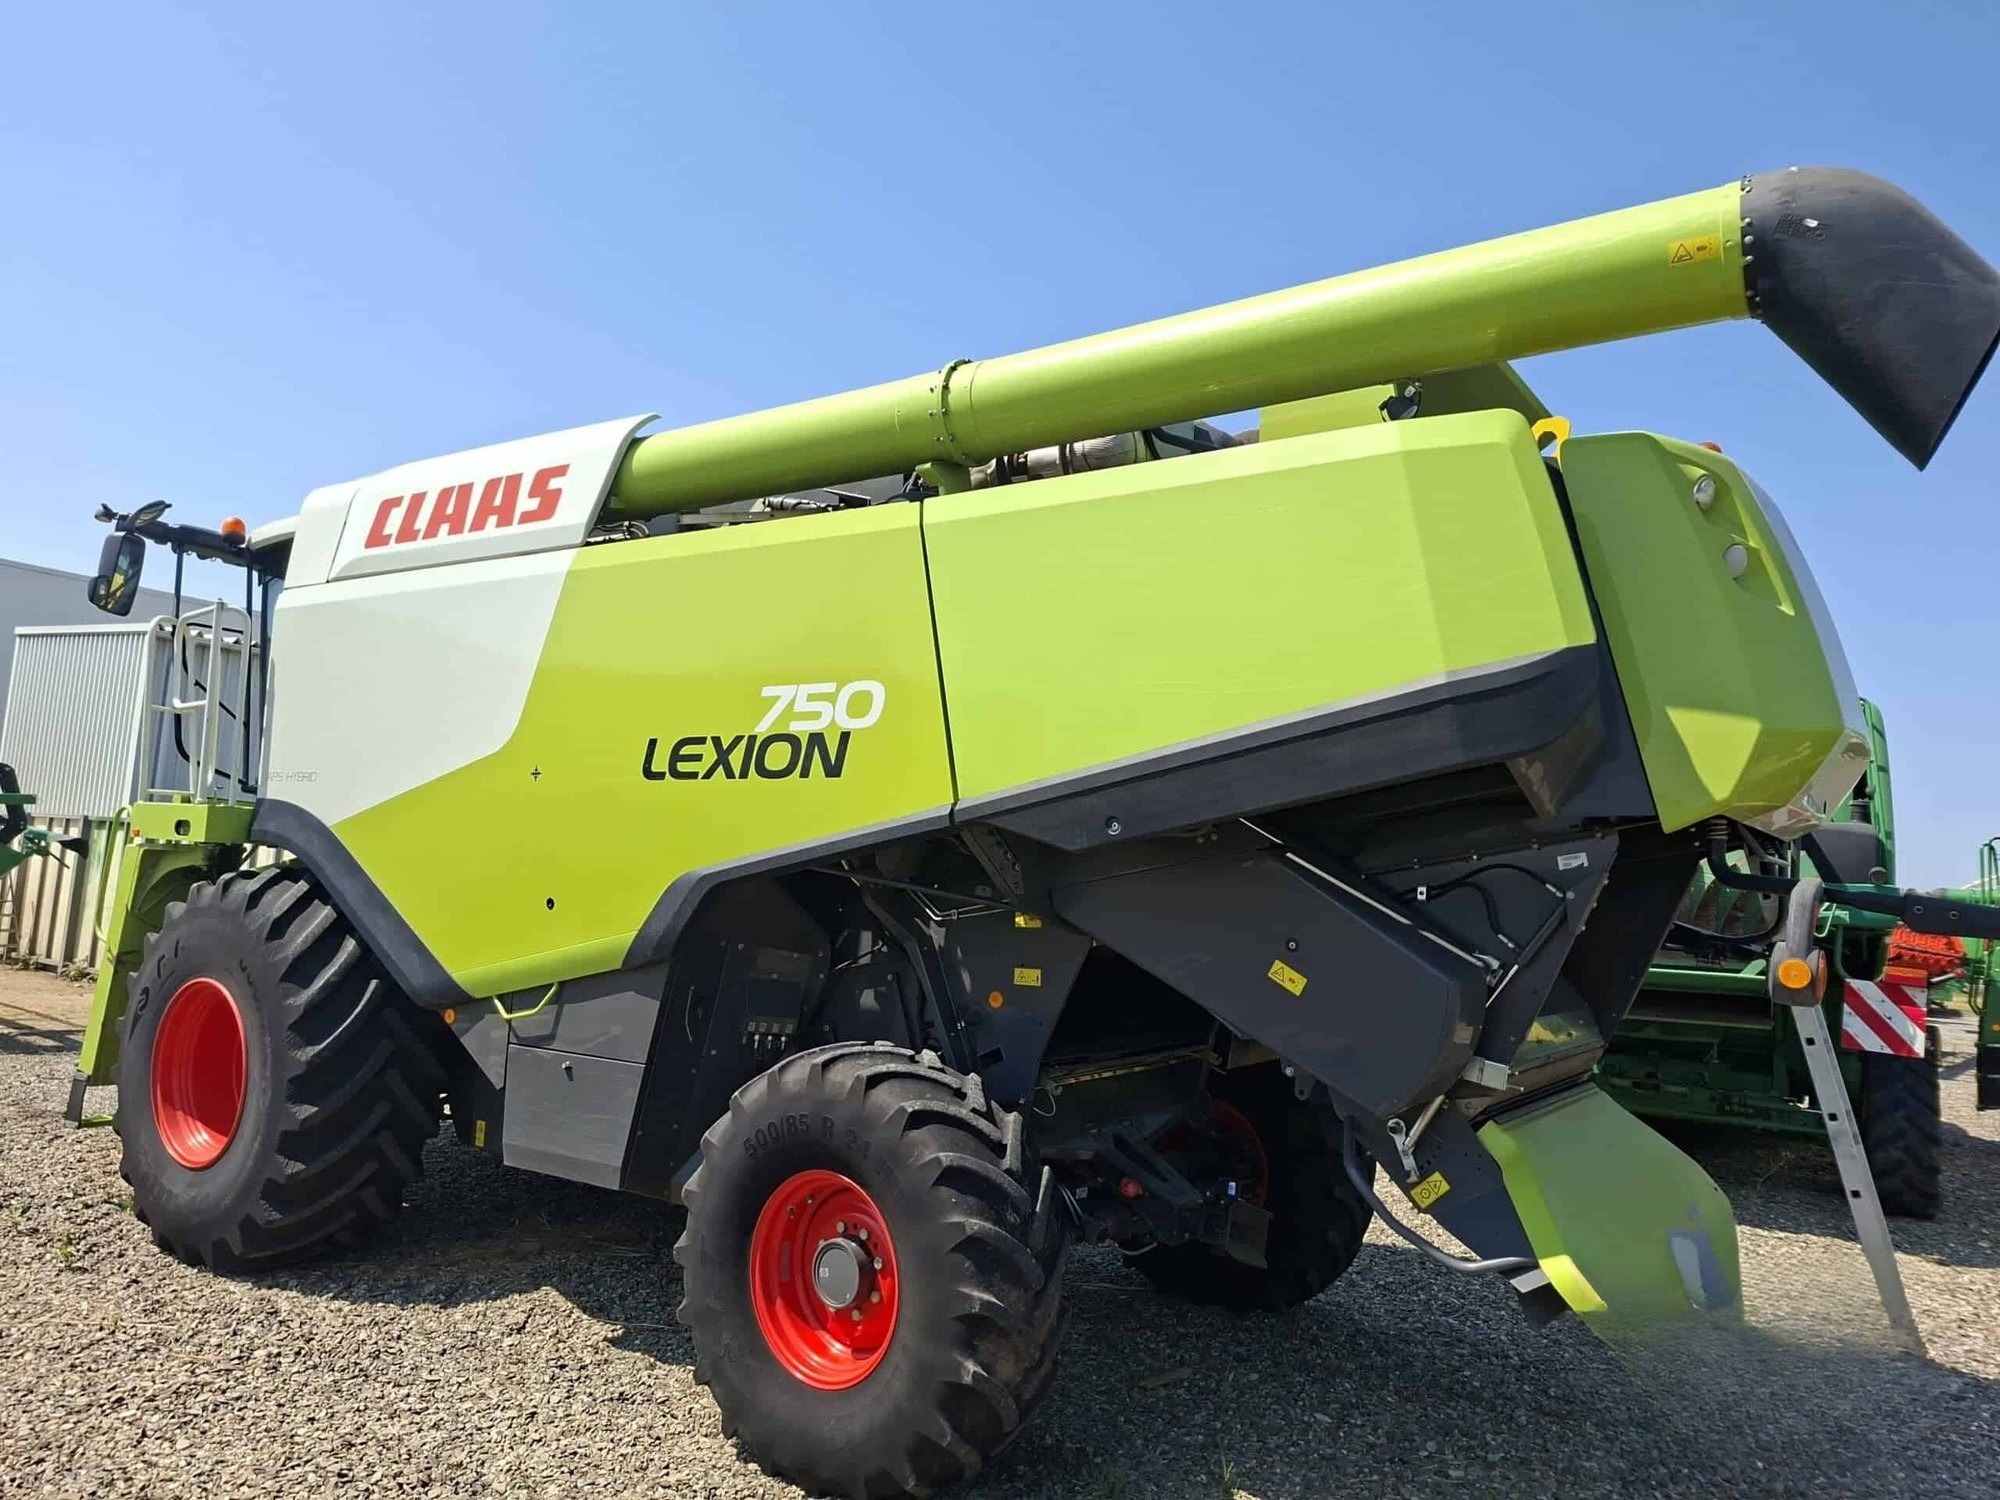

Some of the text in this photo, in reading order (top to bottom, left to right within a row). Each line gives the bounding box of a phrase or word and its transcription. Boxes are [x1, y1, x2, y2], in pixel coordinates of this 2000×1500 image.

[364, 464, 571, 549] CLAAS
[754, 680, 886, 732] 750
[642, 731, 852, 780] LEXION
